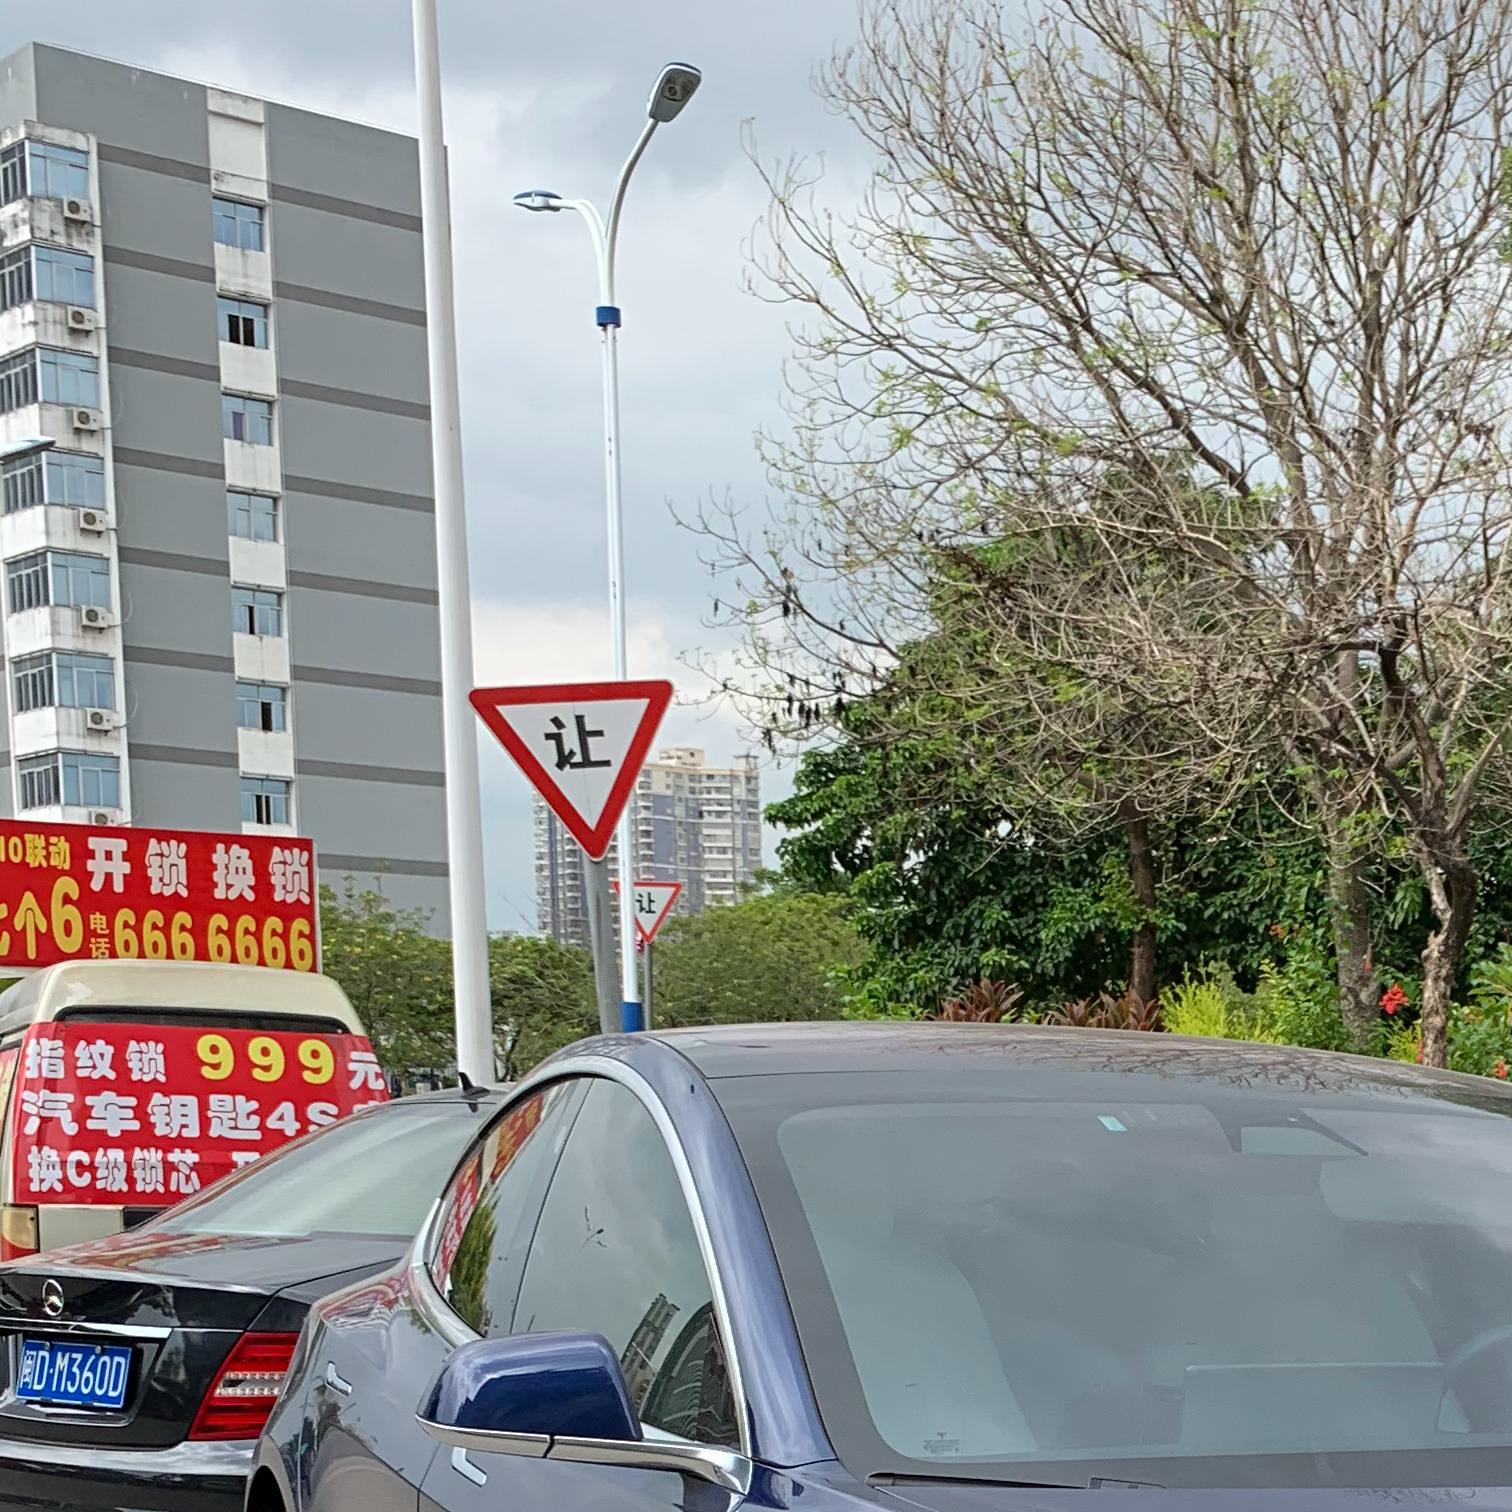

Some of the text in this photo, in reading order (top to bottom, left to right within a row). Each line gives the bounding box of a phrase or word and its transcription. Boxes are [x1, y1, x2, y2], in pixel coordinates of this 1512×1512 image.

[544, 714, 612, 771] 让
[635, 892, 656, 914] 让
[26, 1038, 167, 1083] 指纹锁
[22, 1090, 382, 1140] 汽车钥匙4S
[28, 1145, 200, 1194] 换C级锁芯
